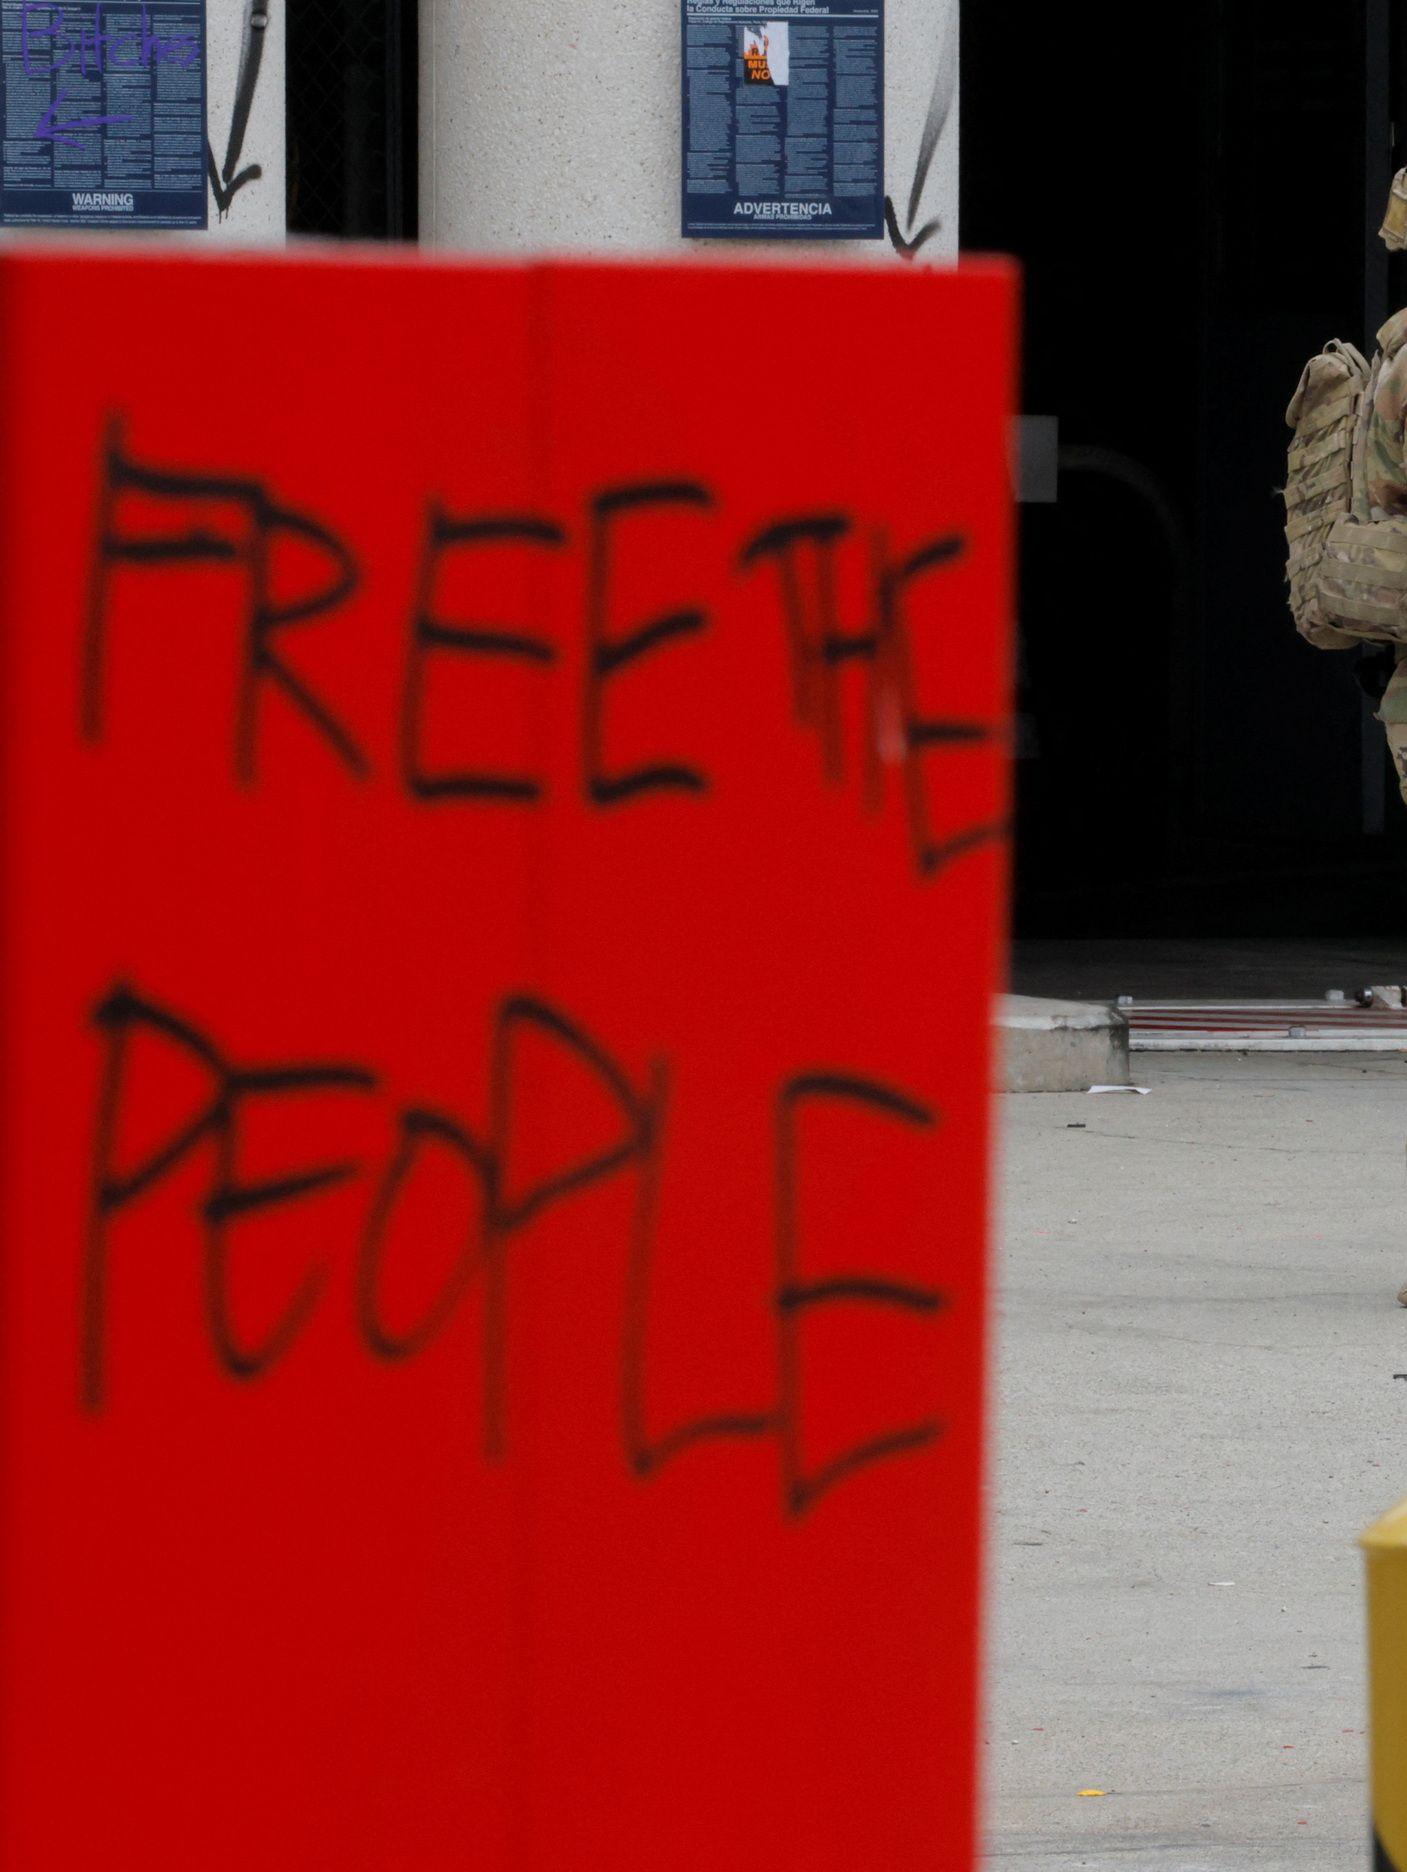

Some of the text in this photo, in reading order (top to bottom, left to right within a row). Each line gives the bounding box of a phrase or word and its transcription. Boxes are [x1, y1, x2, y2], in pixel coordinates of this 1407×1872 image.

[696, 4, 734, 13] Conducta
[735, 5, 758, 13] sobre
[759, 5, 799, 15] Propiedad
[801, 6, 830, 14] Federal
[72, 193, 134, 206] WARNING
[733, 202, 832, 215] ADVERTENCIA
[80, 408, 1008, 880] FREE THE
[80, 976, 946, 1522] PEOPLE
